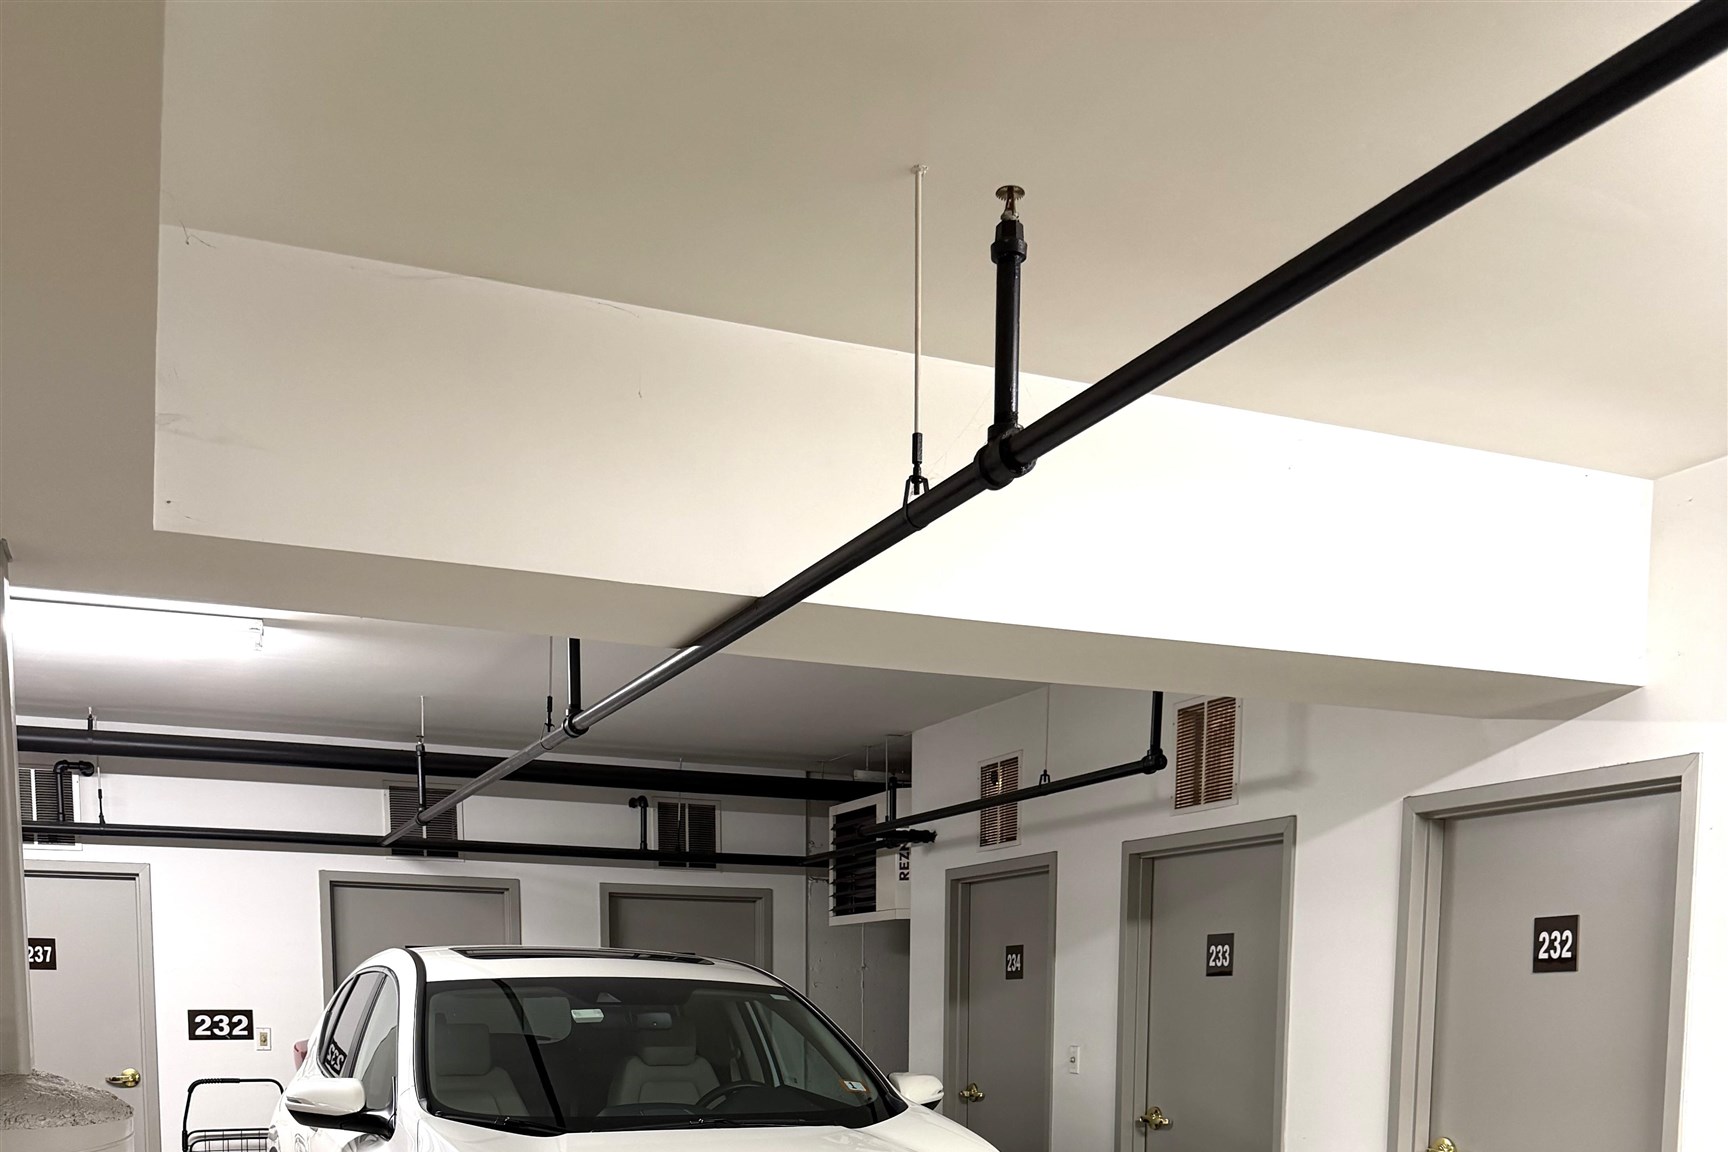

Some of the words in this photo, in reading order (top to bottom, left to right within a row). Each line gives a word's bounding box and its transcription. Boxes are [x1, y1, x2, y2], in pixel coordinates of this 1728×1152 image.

[28, 945, 52, 963] 237
[1209, 944, 1230, 967] 233
[1538, 929, 1573, 960] 232
[1007, 953, 1021, 972] 234
[194, 1014, 249, 1036] 232
